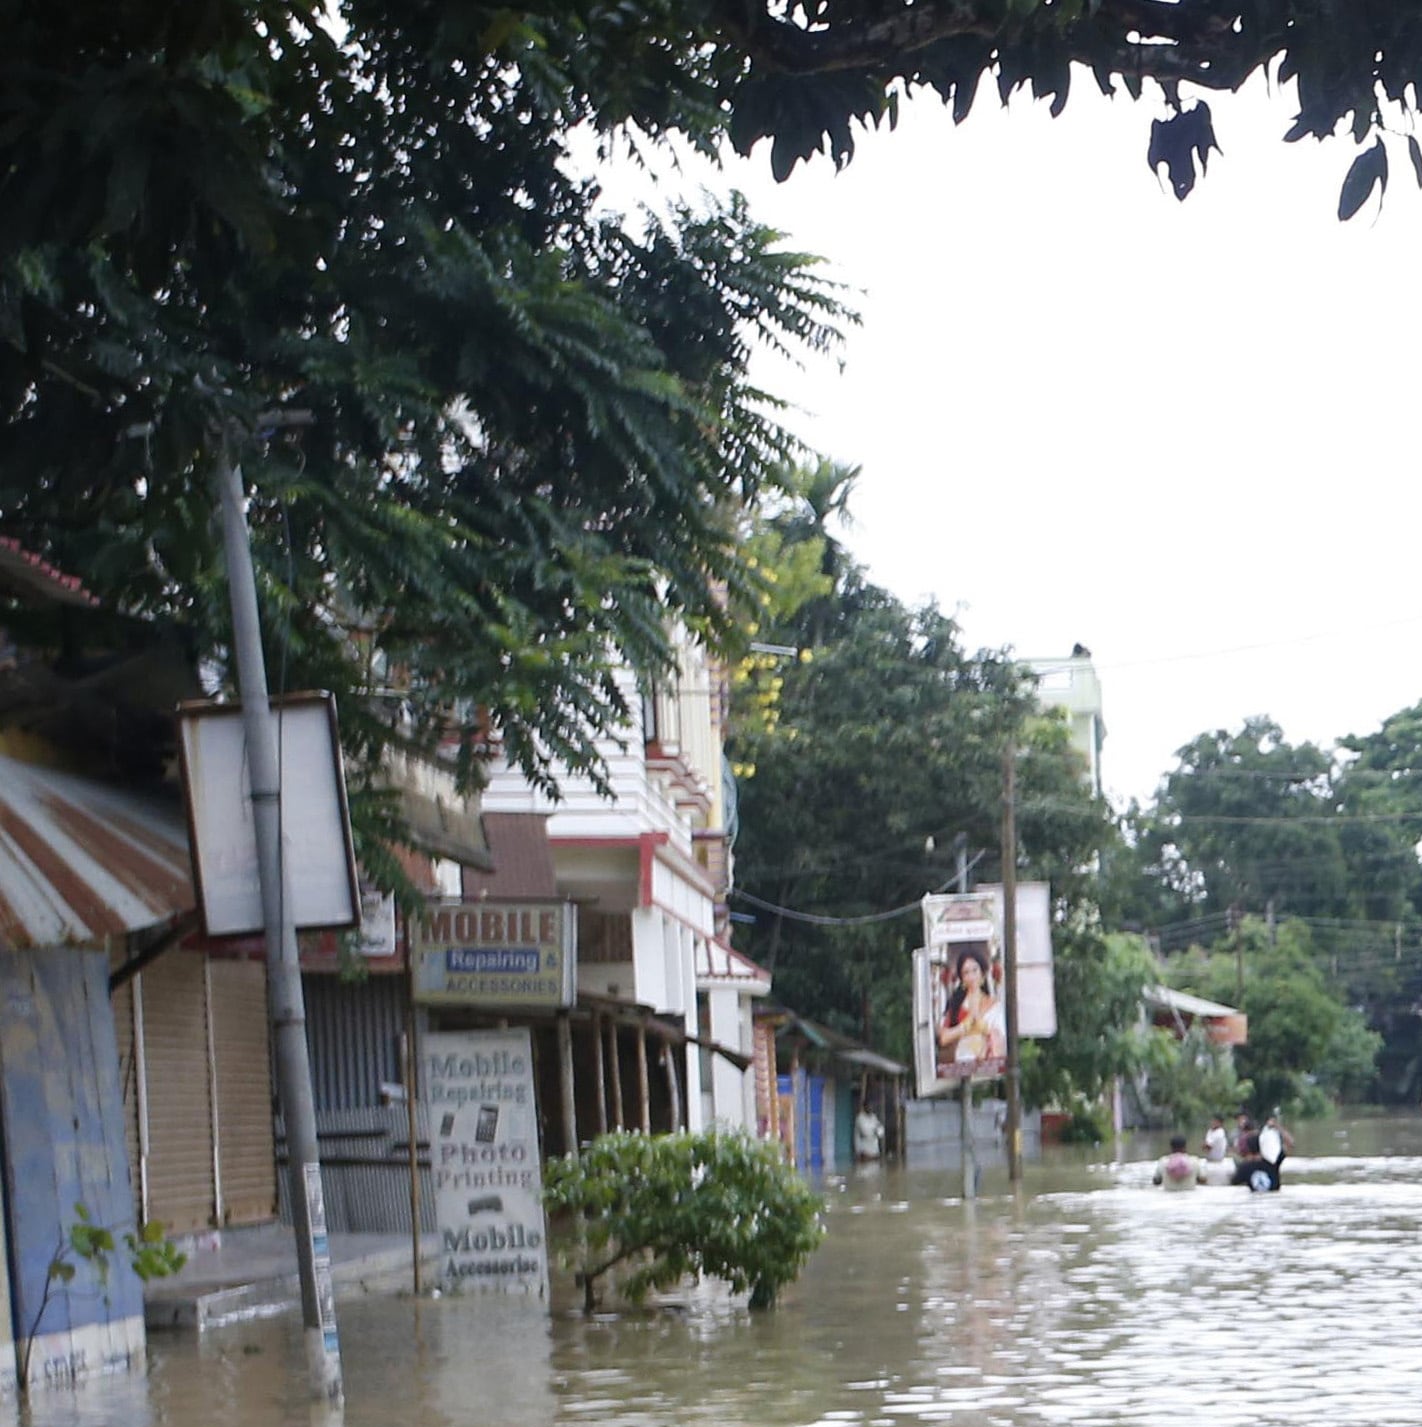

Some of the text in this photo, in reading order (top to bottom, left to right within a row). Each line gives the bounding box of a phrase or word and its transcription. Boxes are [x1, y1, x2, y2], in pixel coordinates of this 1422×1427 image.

[420, 911, 556, 944] MOBILE
[452, 949, 537, 975] Repairing
[446, 978, 558, 995] ACCESSORIES
[430, 1049, 526, 1079] Mobile
[432, 1078, 527, 1108] Repairing
[440, 1142, 527, 1165] Photo
[436, 1165, 534, 1190] Printing
[442, 1222, 542, 1254] Mobile
